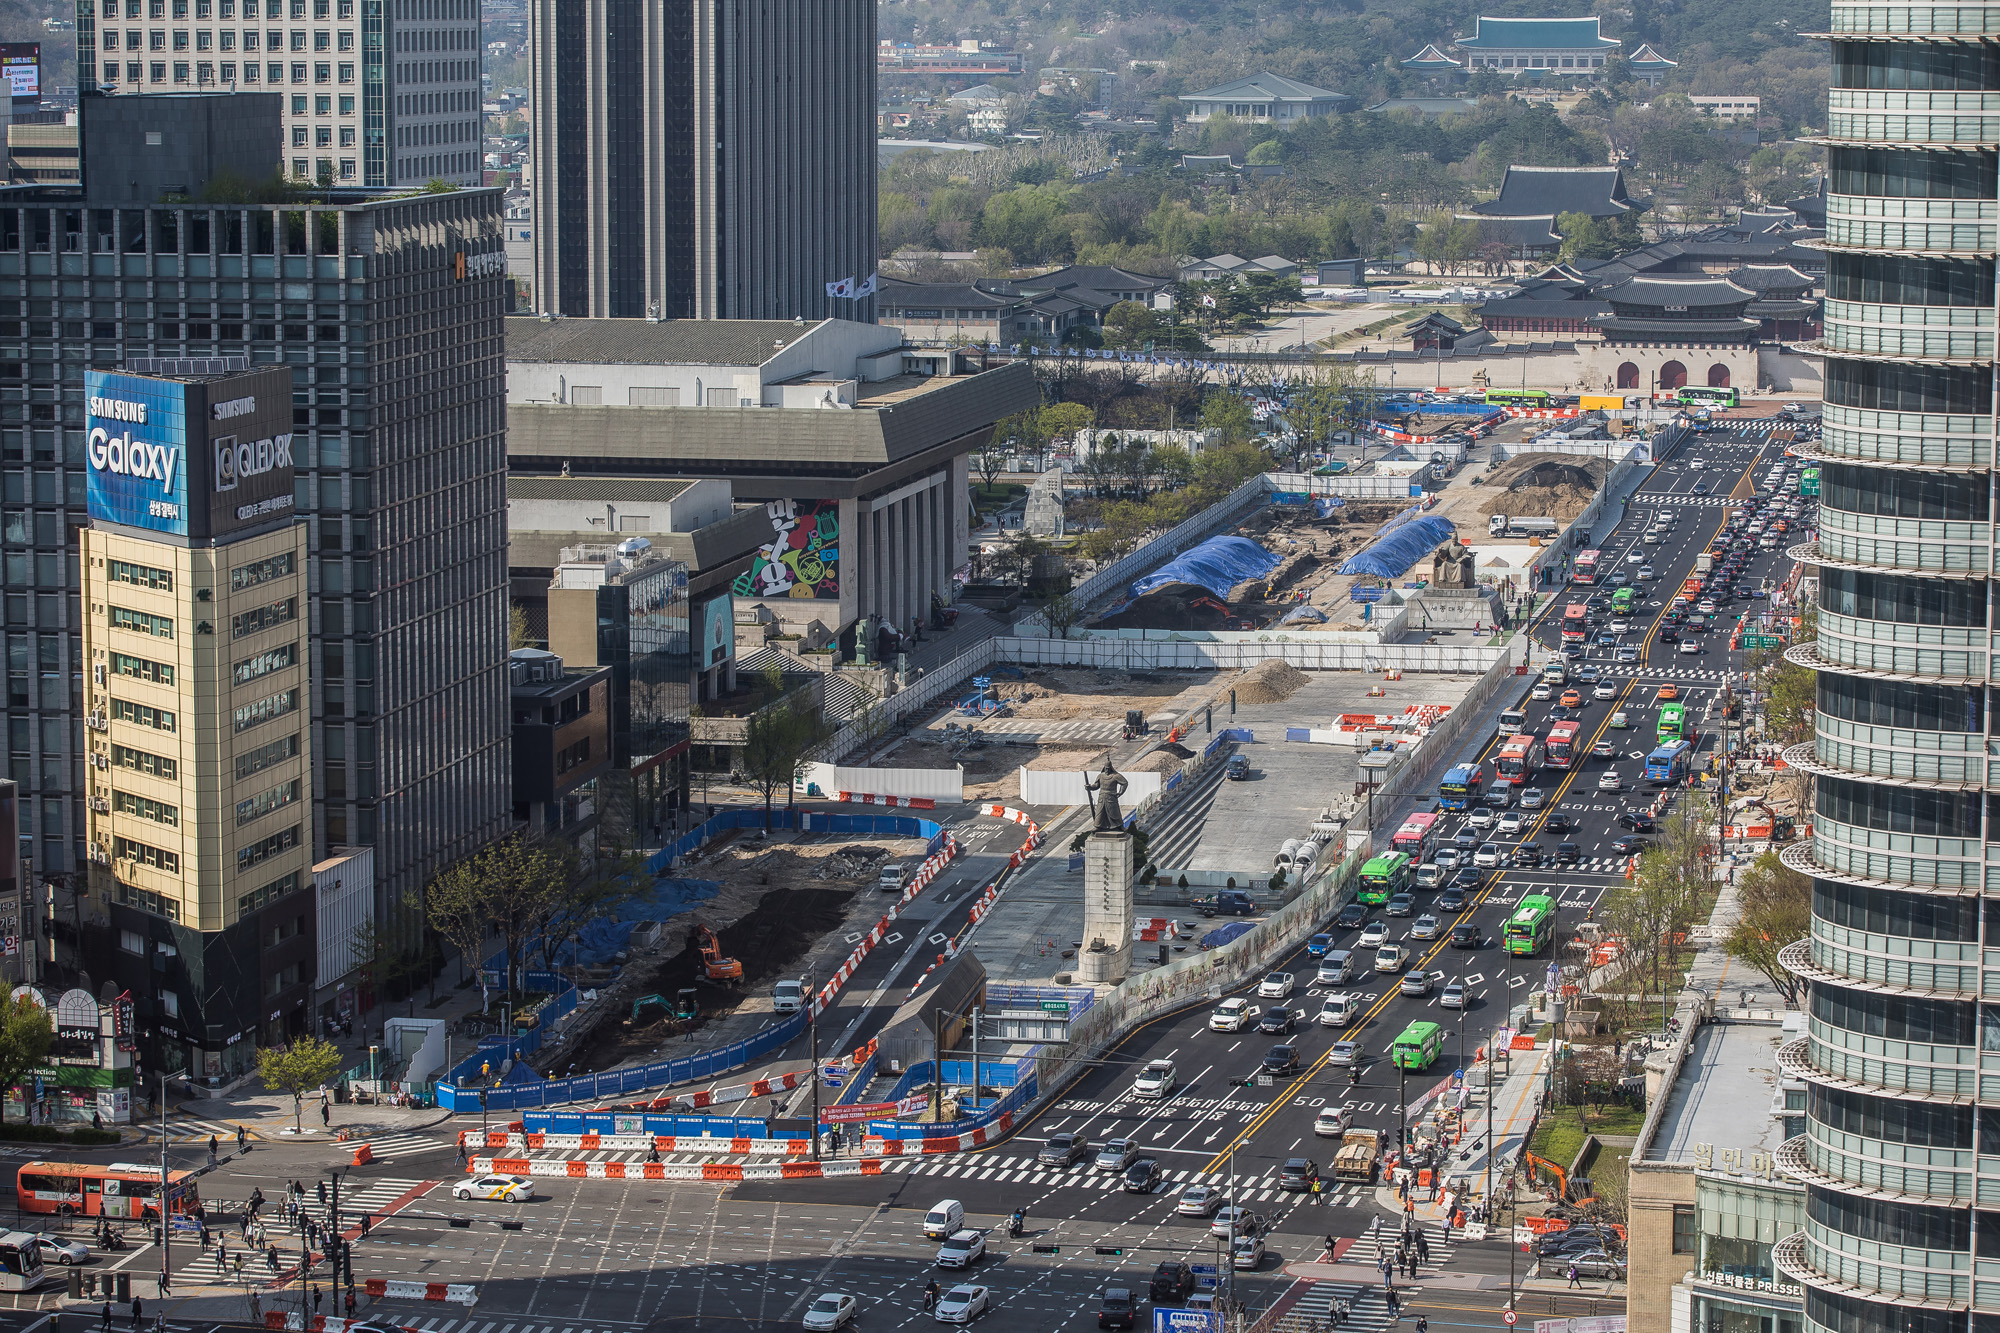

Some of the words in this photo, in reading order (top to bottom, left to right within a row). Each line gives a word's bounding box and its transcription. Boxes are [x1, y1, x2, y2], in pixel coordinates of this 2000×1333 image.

[90, 396, 147, 424] SAMSUNG
[214, 396, 255, 420] SAMSUNG
[88, 427, 178, 493] Galaxy
[237, 438, 275, 477] QLED
[274, 433, 294, 469] 8K
[1592, 804, 1616, 812] 50
[60, 1029, 95, 1040] 마녀김밥
[895, 1098, 911, 1117] 12
[1293, 1096, 1326, 1107] 50
[1343, 1101, 1375, 1112] 50
[1706, 1271, 1754, 1290] 신문박물관
